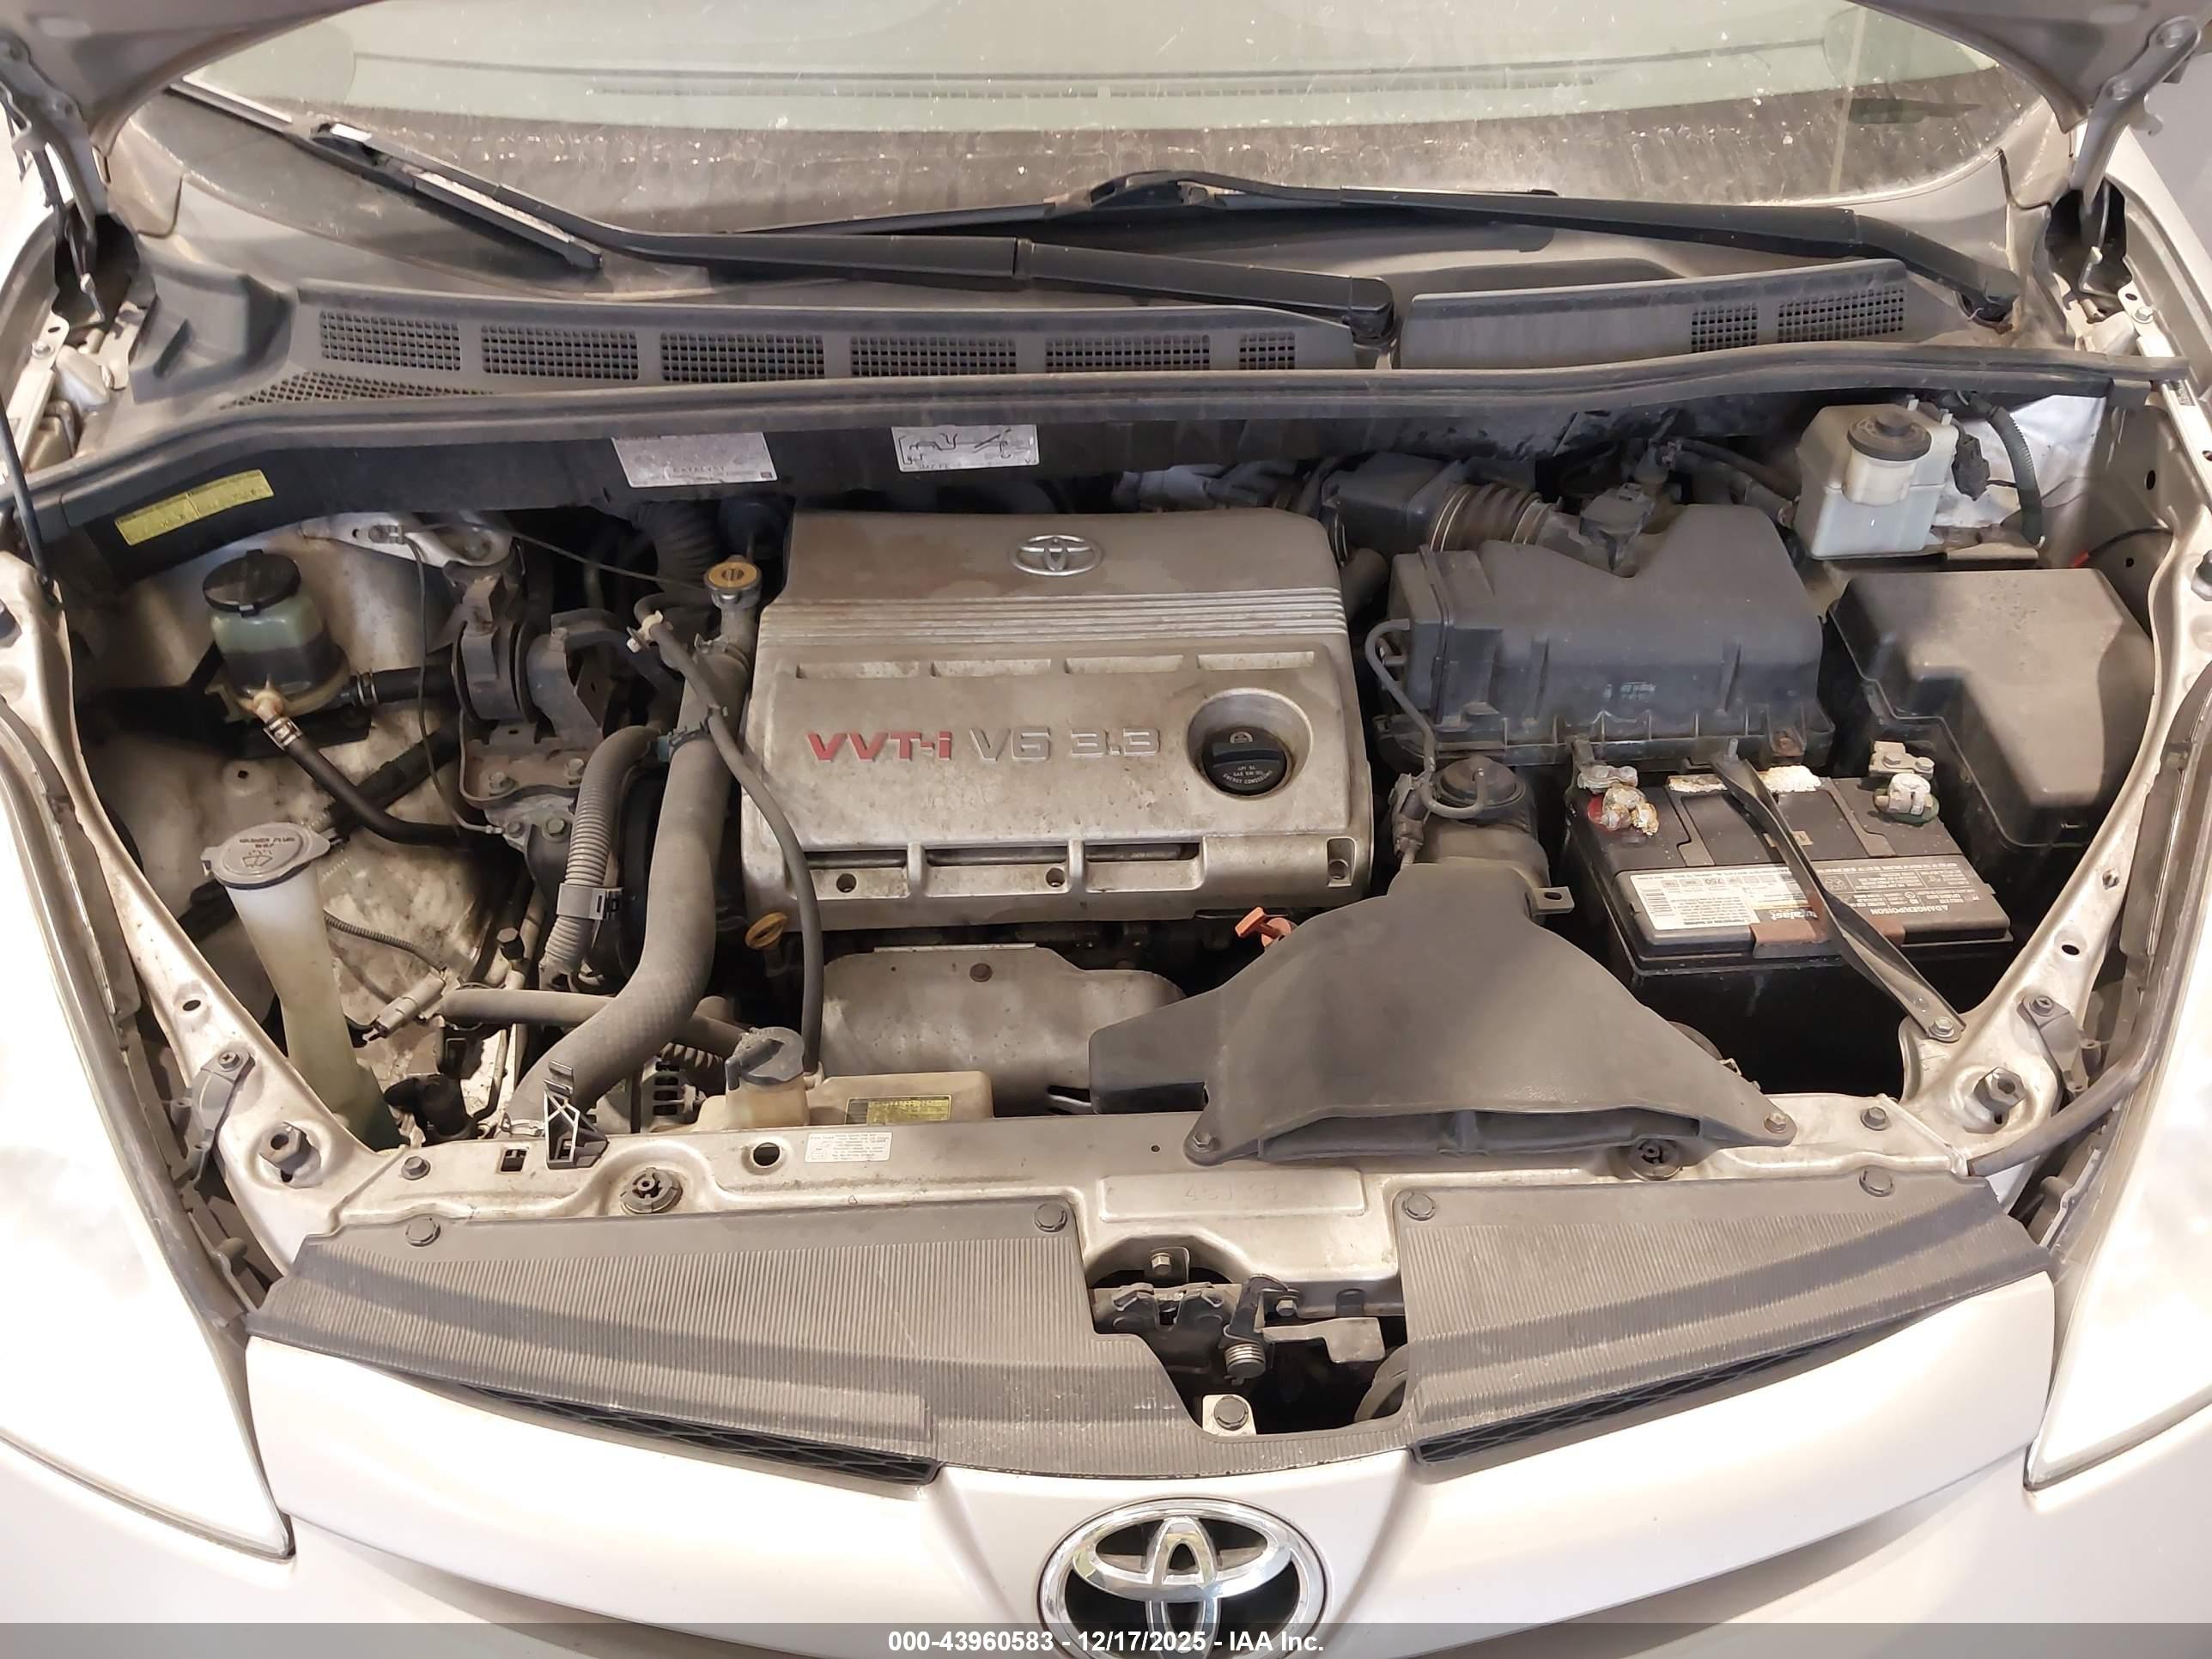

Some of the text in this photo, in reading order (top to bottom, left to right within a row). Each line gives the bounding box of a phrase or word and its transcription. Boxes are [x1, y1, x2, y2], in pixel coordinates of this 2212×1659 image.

[806, 726, 1161, 762] VVT-i V6 3.3
